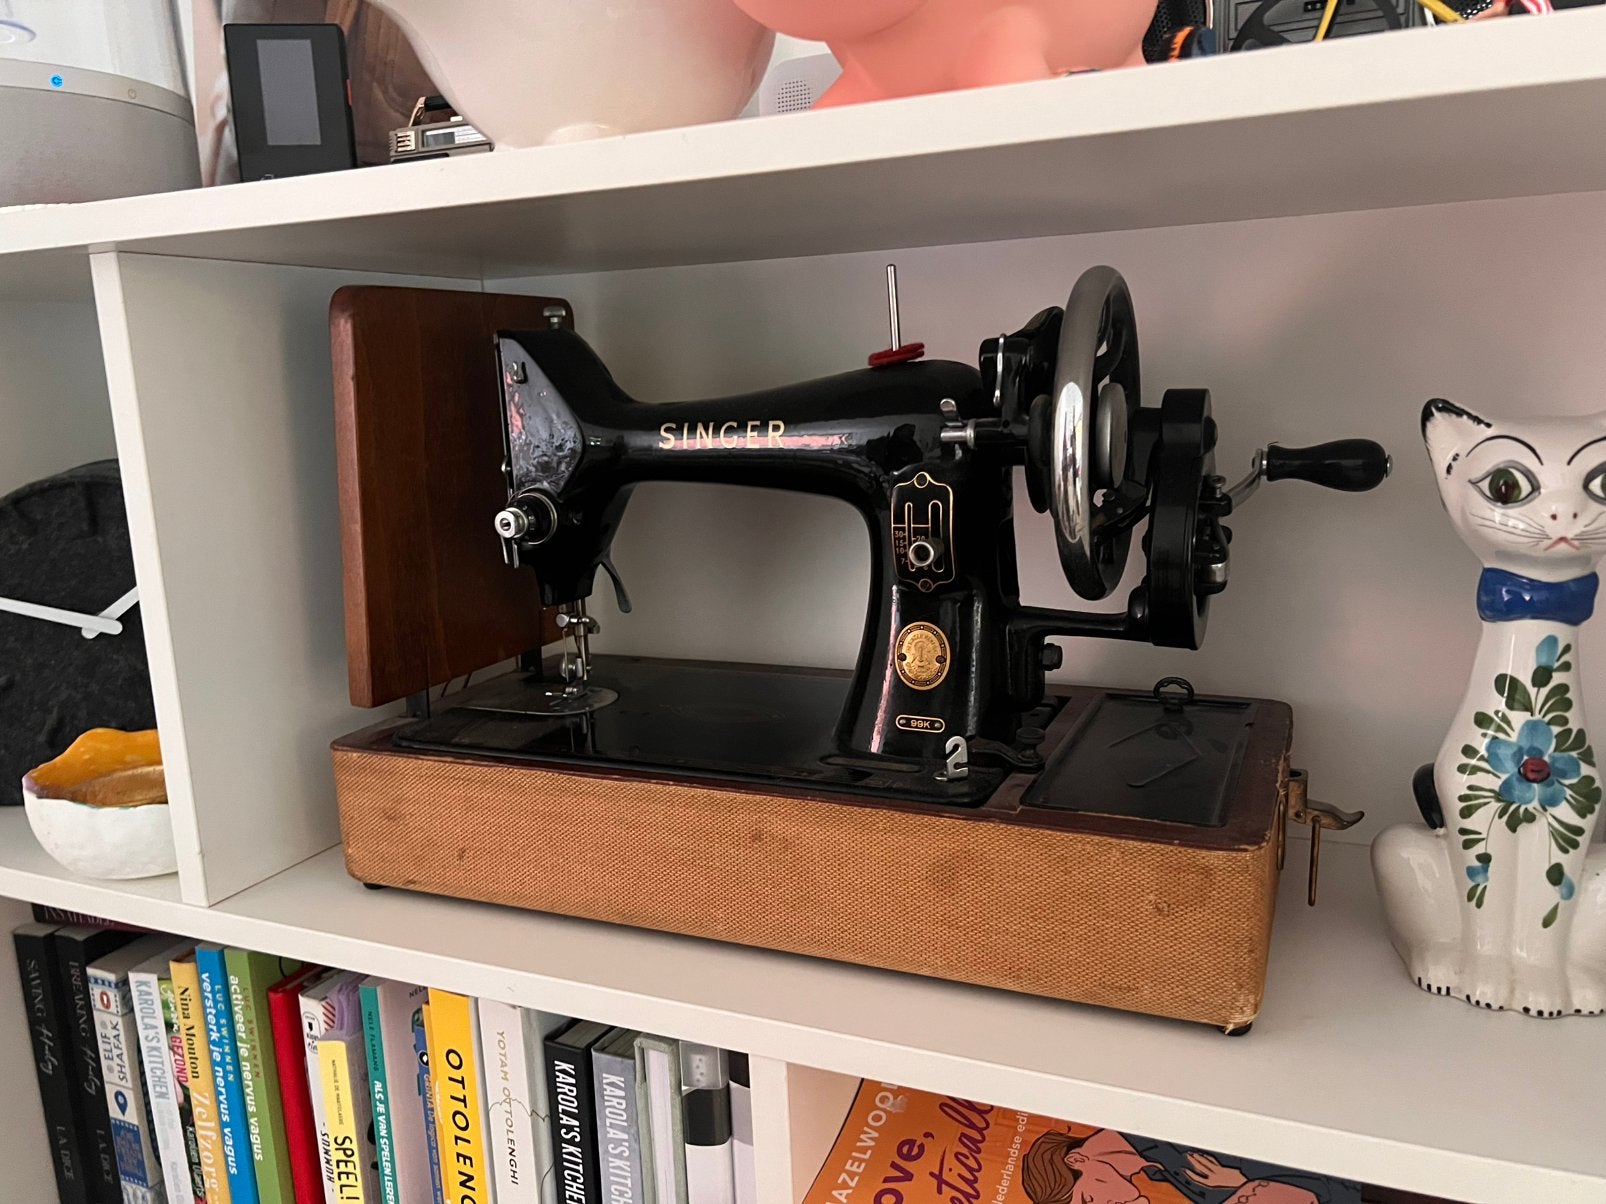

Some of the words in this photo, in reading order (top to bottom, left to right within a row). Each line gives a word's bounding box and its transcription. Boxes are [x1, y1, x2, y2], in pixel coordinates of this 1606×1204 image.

[658, 420, 785, 449] SINGER
[894, 530, 904, 538] 30
[895, 539, 904, 547] 15
[910, 719, 931, 729] 99K
[26, 958, 46, 1017] SAVING
[135, 980, 160, 1044] KAROLA'S
[178, 985, 192, 1019] Nina
[201, 972, 220, 1041] versterk
[229, 975, 246, 1039] activeer
[101, 1032, 114, 1061] ELIF
[110, 1019, 128, 1083] SHAFAK
[184, 1023, 199, 1079] Mouton
[209, 1043, 222, 1062] je
[215, 984, 225, 1011] LUC
[220, 1018, 234, 1082] SWINNEN
[237, 1040, 250, 1057] je
[242, 986, 252, 1012] LUC
[247, 1018, 260, 1079] SWINNEN
[496, 1031, 510, 1082] YOTAM
[146, 1045, 170, 1100] KITCHEN
[170, 1035, 189, 1083] GEZOND
[214, 1066, 230, 1122] nervus
[241, 1061, 256, 1113] nervus
[374, 1080, 385, 1101] ALS
[376, 1100, 386, 1113] JE
[554, 1060, 580, 1142] KAROLA'S
[193, 1092, 218, 1190] Zelfzorg
[249, 1117, 263, 1161] vagus
[377, 1115, 388, 1137] VAN
[502, 1086, 519, 1185] OTTOLENGHI
[602, 1073, 630, 1157] KAROLA'S
[223, 1127, 237, 1175] vagus
[320, 1131, 335, 1183] HUMMUS
[333, 1135, 360, 1200] SPEEL!
[380, 1137, 392, 1176] SPELEN
[825, 1082, 898, 1204] AZELWOO
[561, 1143, 586, 1204] KITCHE
